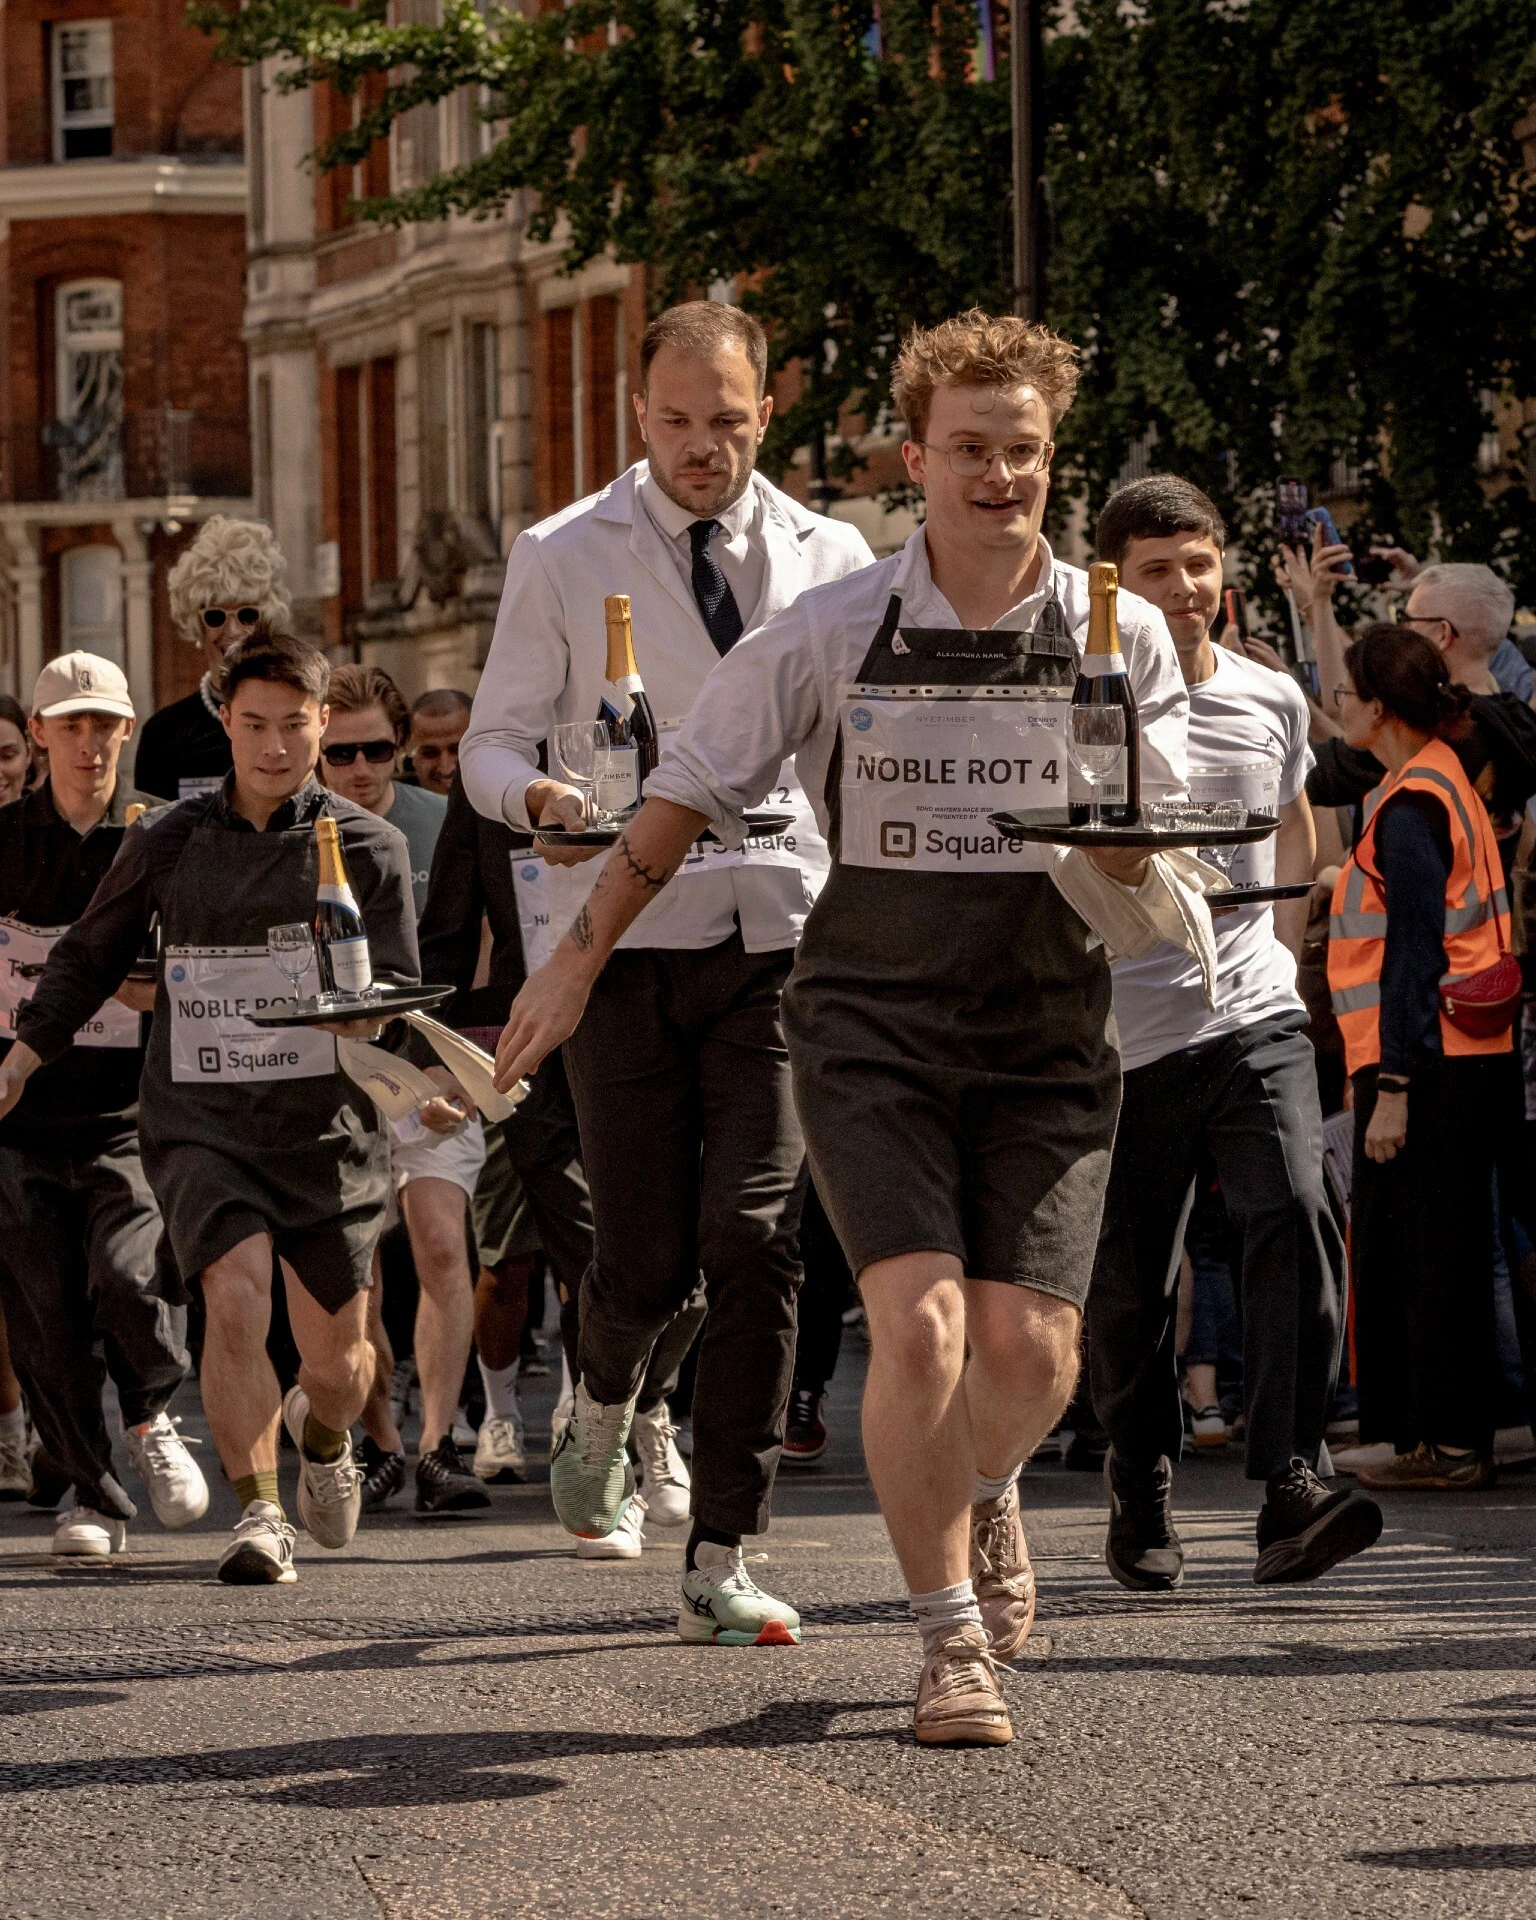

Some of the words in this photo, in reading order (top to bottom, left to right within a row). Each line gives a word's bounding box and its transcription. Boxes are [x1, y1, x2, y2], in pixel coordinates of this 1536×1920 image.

[856, 754, 956, 785] NOBLE
[968, 759, 1033, 785] ROT
[1041, 759, 1060, 785] 4
[777, 786, 793, 804] 2
[925, 829, 1024, 860] Square
[178, 999, 247, 1019] NOBLE
[227, 1050, 299, 1072] Square
